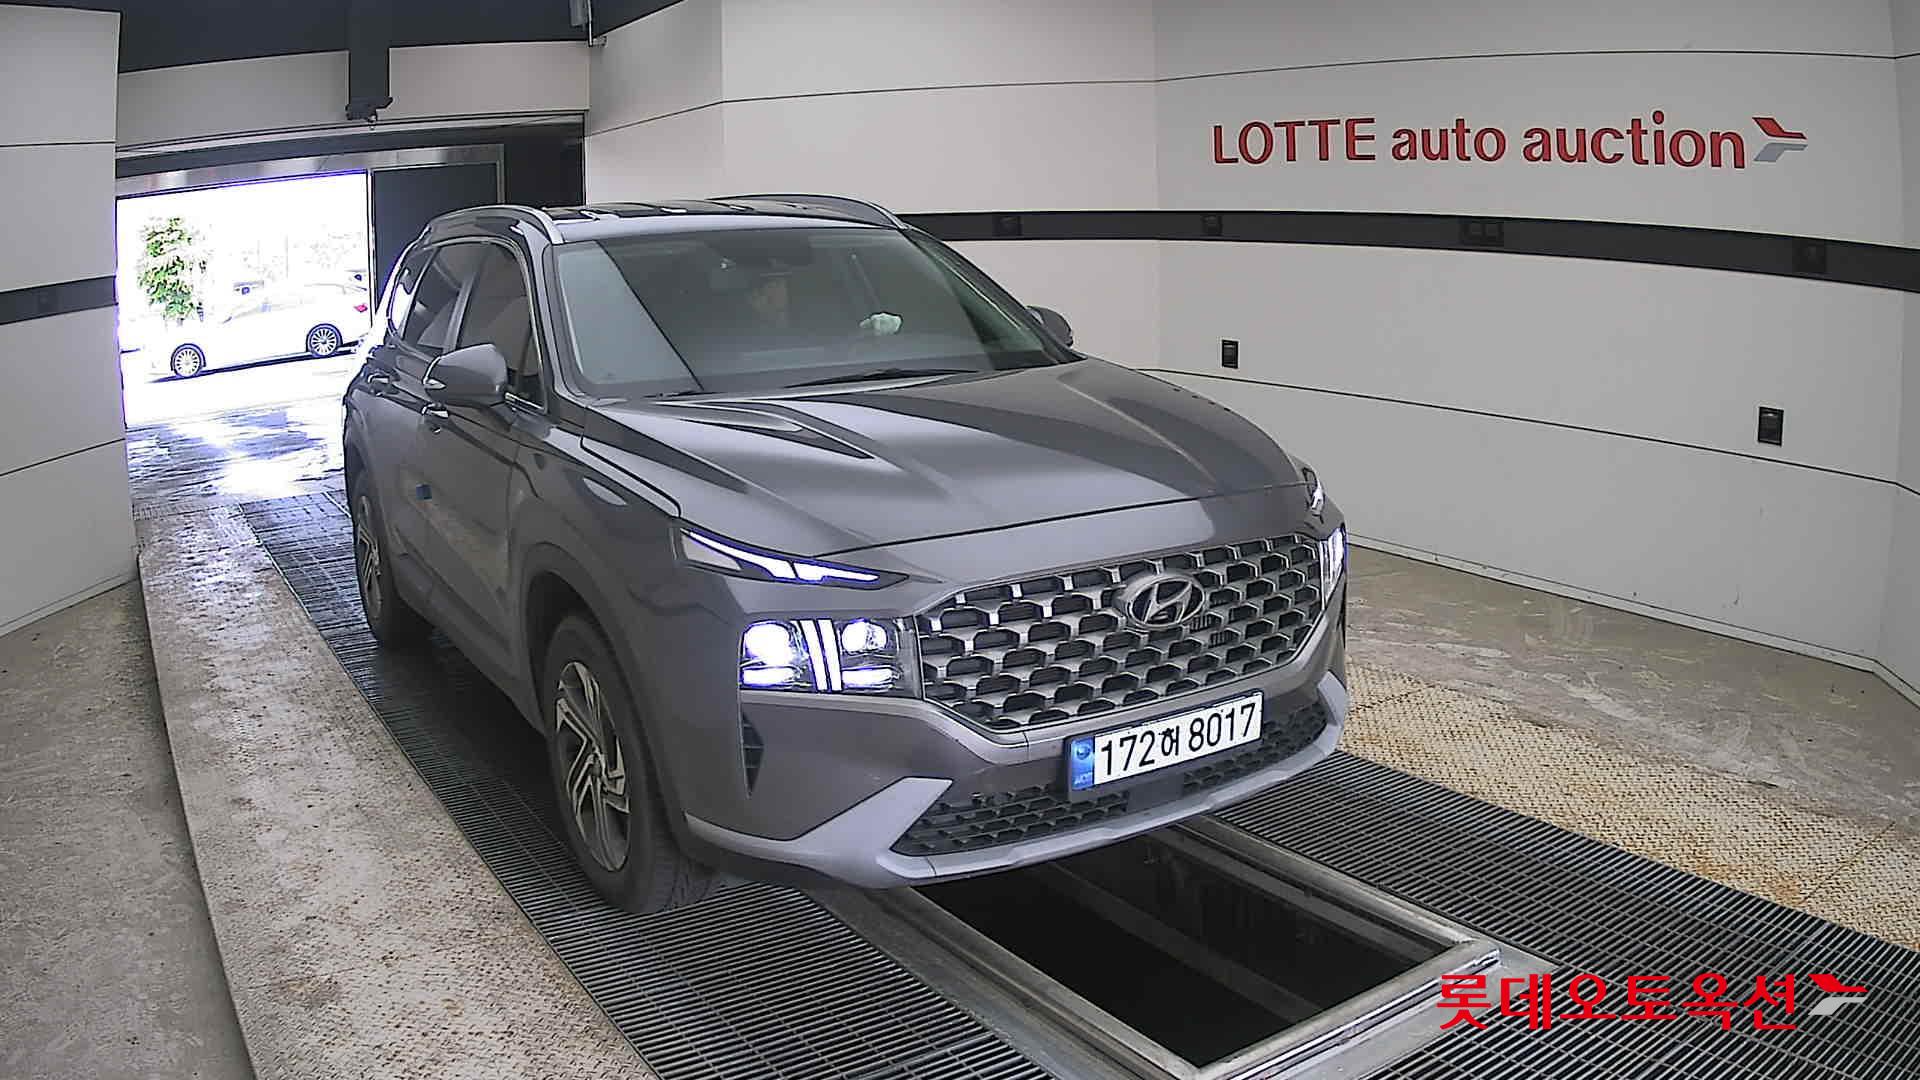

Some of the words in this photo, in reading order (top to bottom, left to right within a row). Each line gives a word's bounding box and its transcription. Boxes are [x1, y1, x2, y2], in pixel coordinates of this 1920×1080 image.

[1213, 117, 1377, 165] LOTTE
[1391, 118, 1507, 163] auto
[1522, 110, 1746, 169] auction
[1188, 702, 1256, 752] 8017
